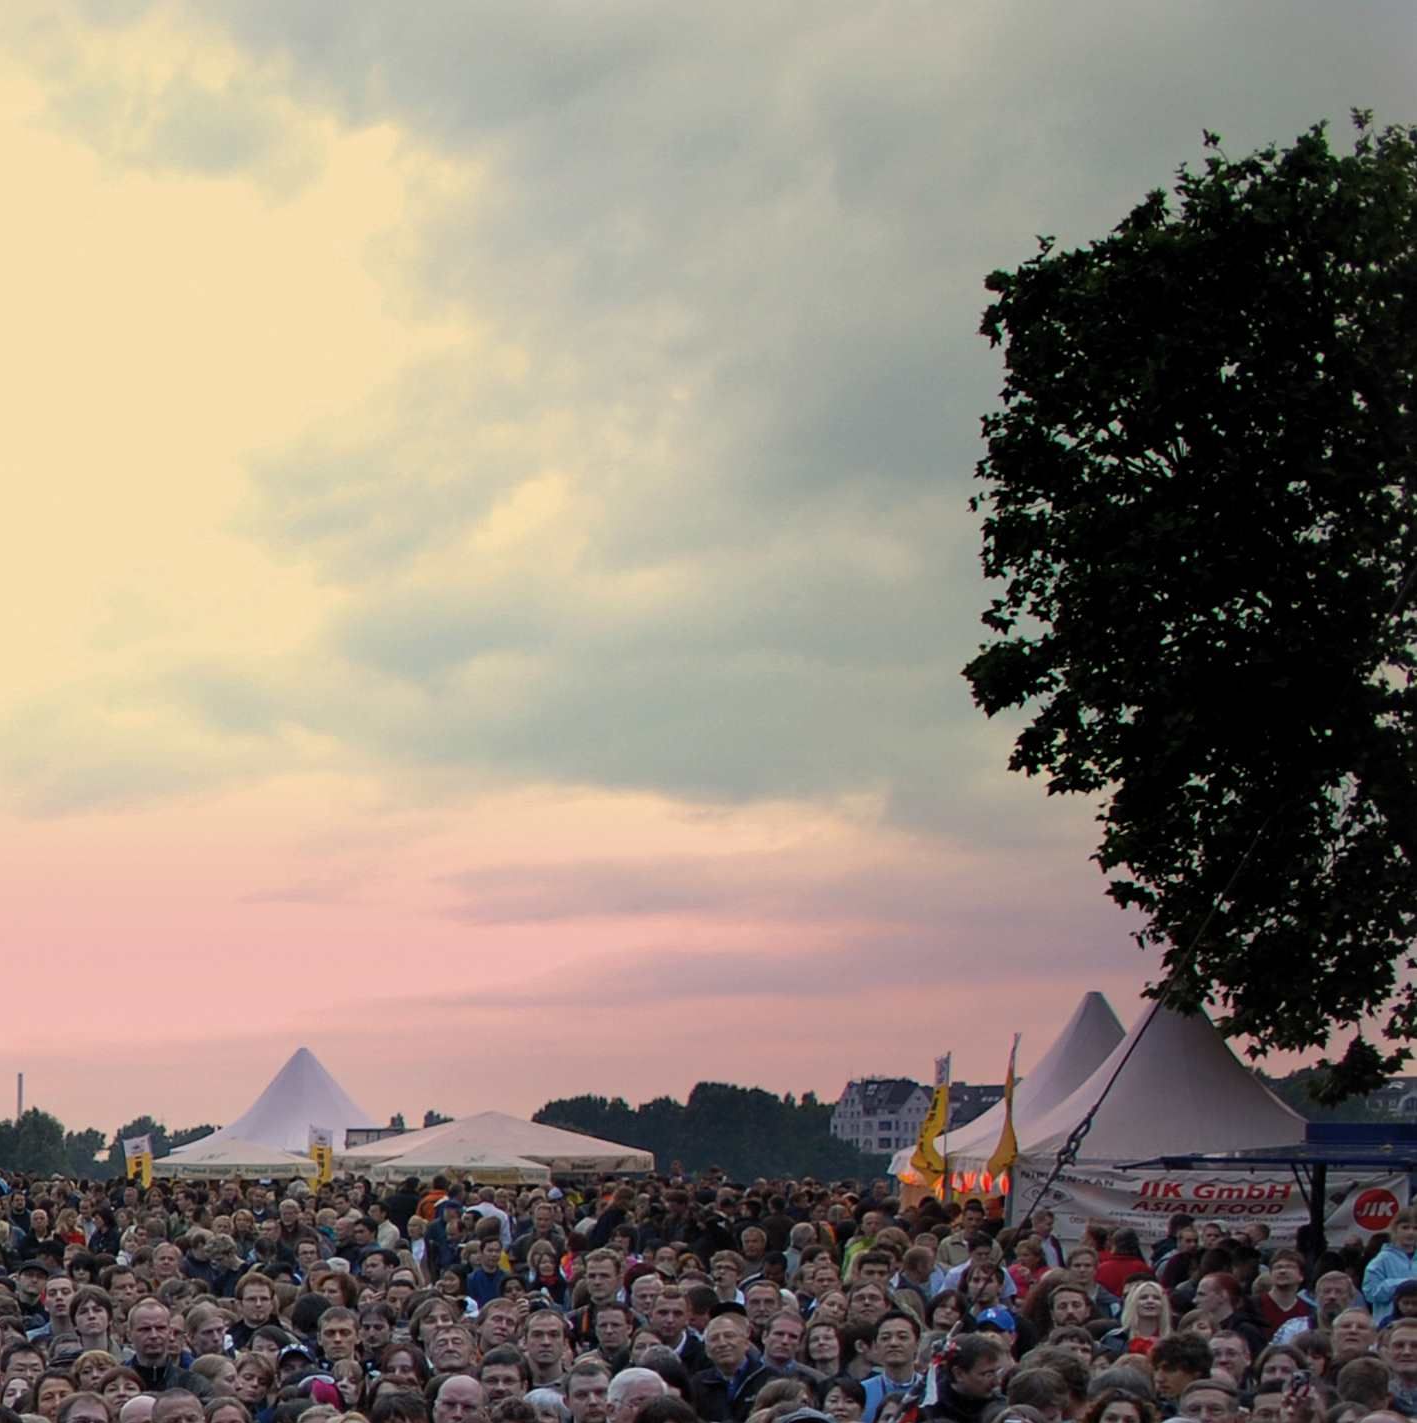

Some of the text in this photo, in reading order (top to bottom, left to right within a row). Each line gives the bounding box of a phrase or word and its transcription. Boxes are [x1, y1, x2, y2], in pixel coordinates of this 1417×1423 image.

[1131, 1182, 1292, 1200] JIK GmbH
[1131, 1200, 1285, 1216] ASIAN FOOD
[1356, 1201, 1397, 1217] JIK
